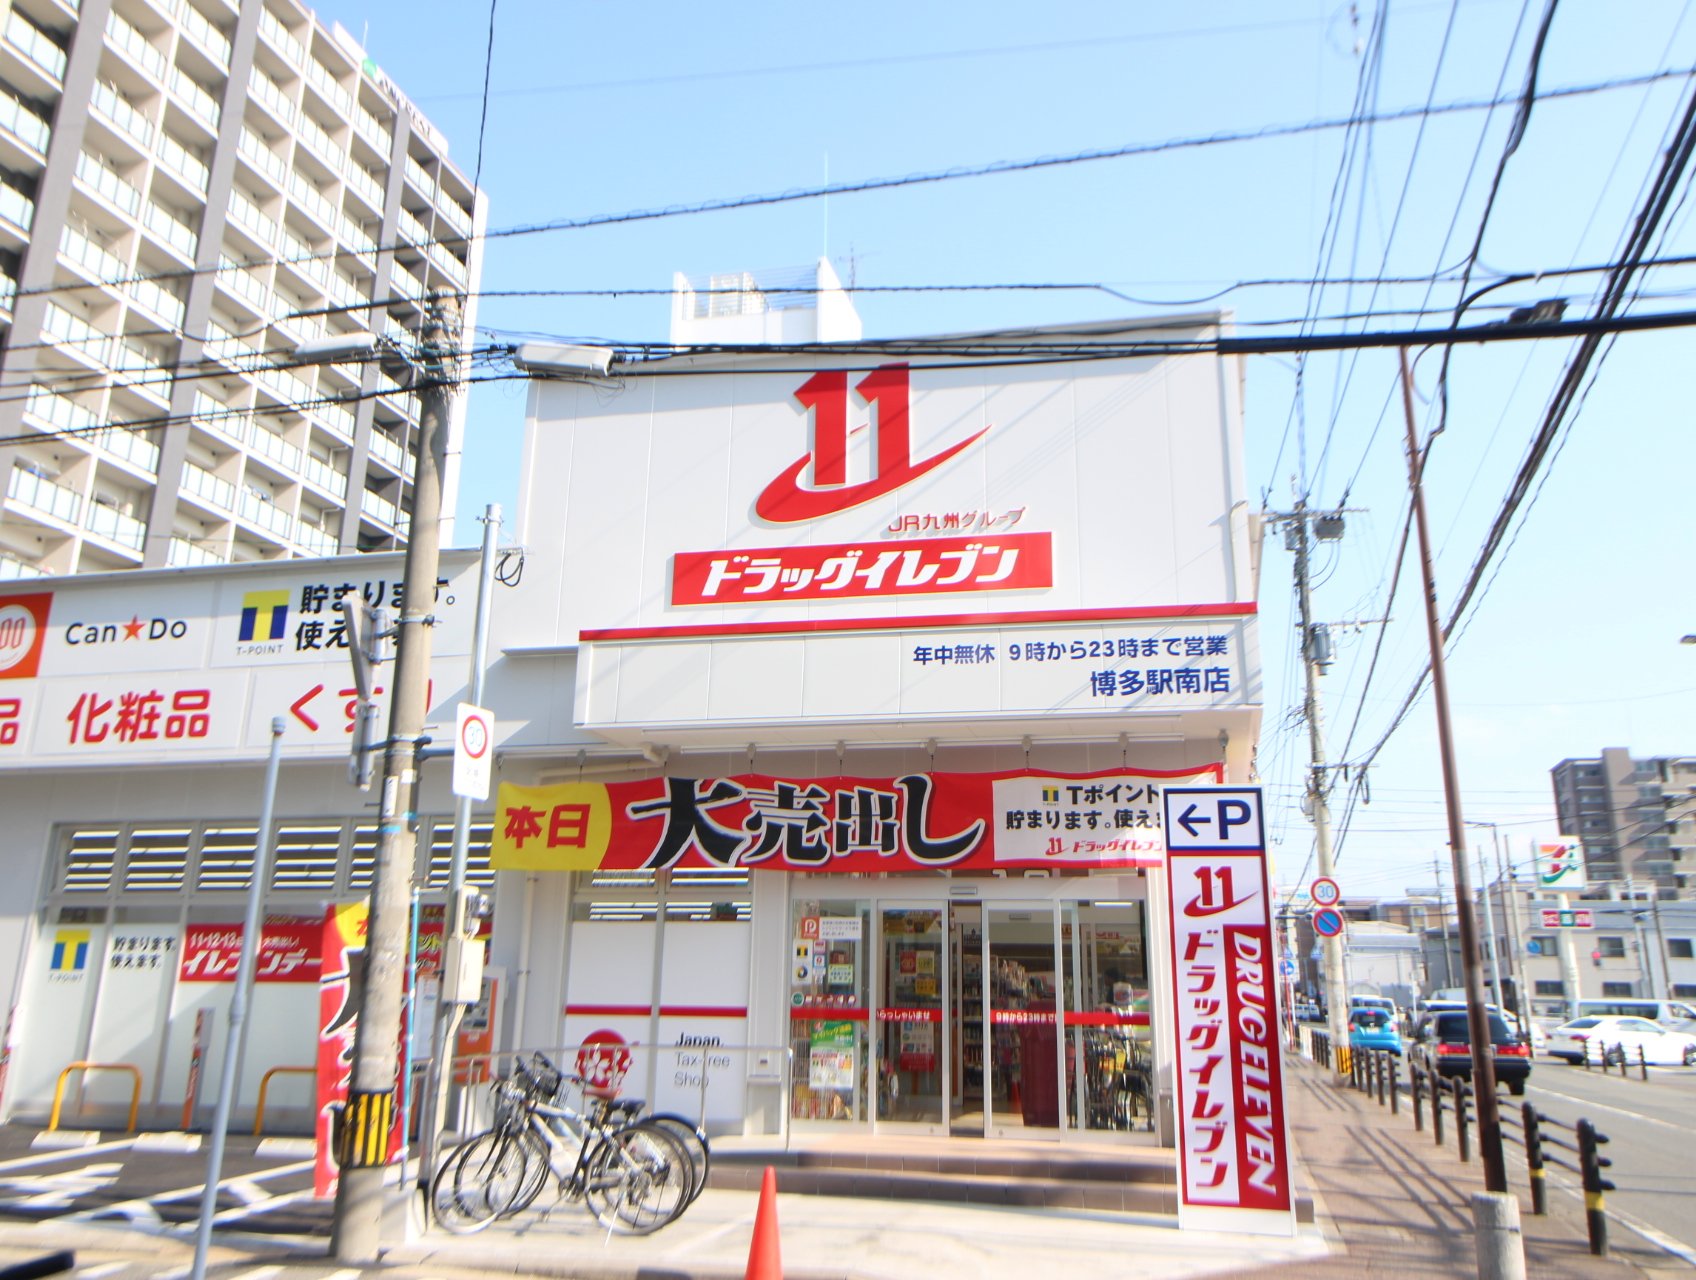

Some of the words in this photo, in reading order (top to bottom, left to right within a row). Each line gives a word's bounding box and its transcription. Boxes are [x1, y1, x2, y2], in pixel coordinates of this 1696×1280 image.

[888, 506, 1027, 532] JR九州グループ
[701, 544, 1020, 597] ドラッグイレブン
[235, 644, 285, 655] T-POINT
[913, 645, 996, 666] 年中無休
[1008, 635, 1229, 662] 9時から23時まで営業
[1090, 667, 1231, 697] 博多駅南店
[66, 688, 211, 744] 化粧品
[468, 726, 483, 747] 30
[505, 803, 591, 849] 本日
[626, 774, 986, 869] 大売出し
[1217, 799, 1252, 840] P
[1317, 886, 1334, 898] 30
[1183, 929, 1229, 1188] ドラッグイレブン
